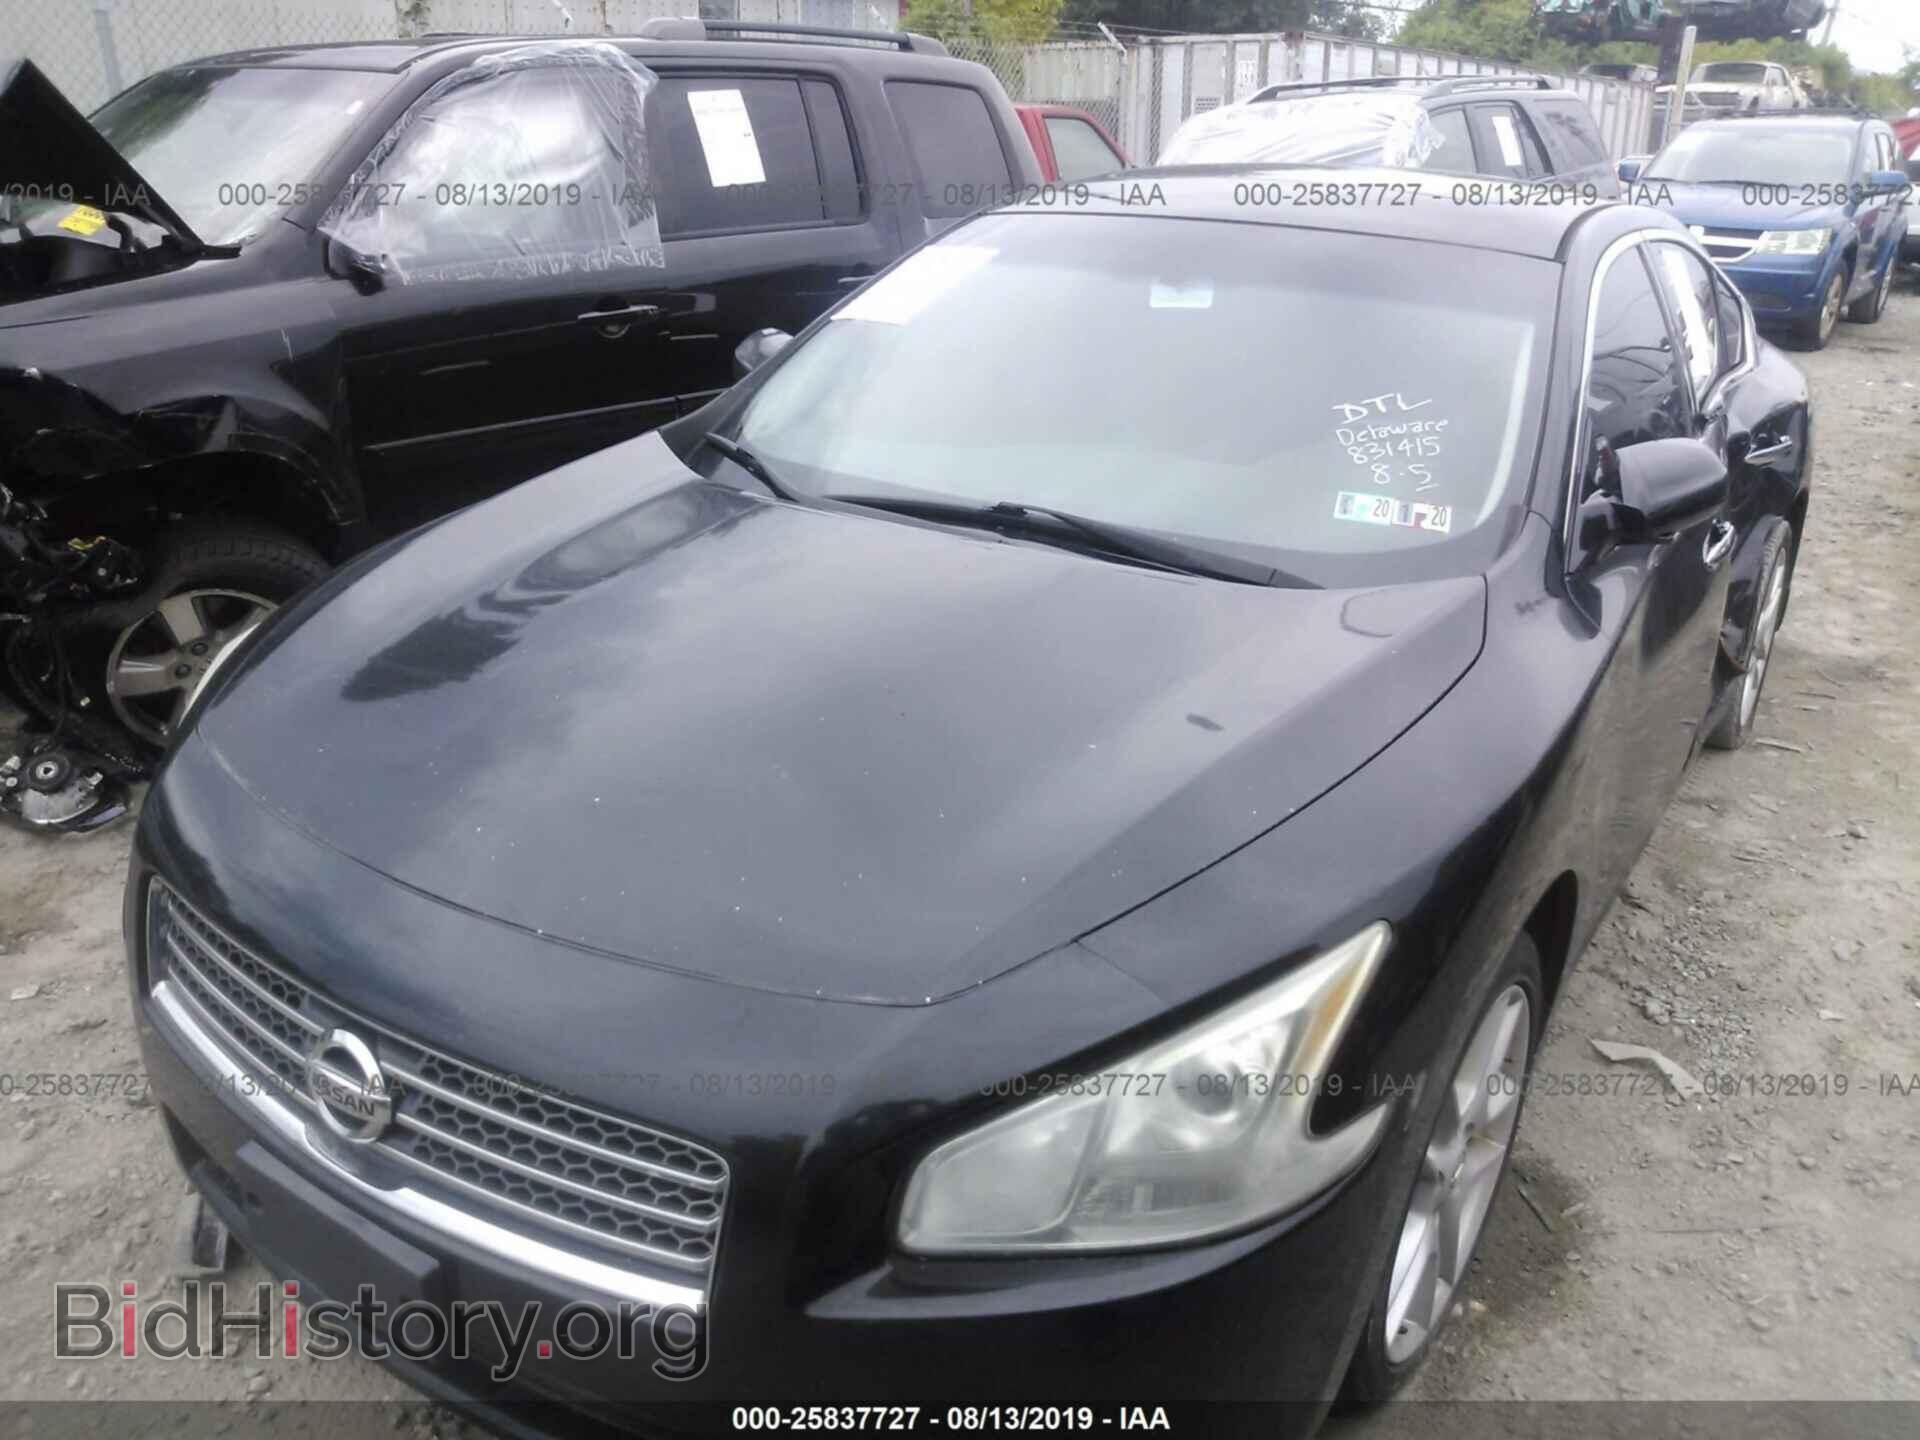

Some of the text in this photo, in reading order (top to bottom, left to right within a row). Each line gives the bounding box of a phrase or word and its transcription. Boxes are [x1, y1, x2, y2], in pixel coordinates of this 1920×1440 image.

[1331, 393, 1433, 425] DTL
[1347, 435, 1441, 465] 831415
[1373, 498, 1391, 518] 20
[1430, 505, 1448, 528] 20
